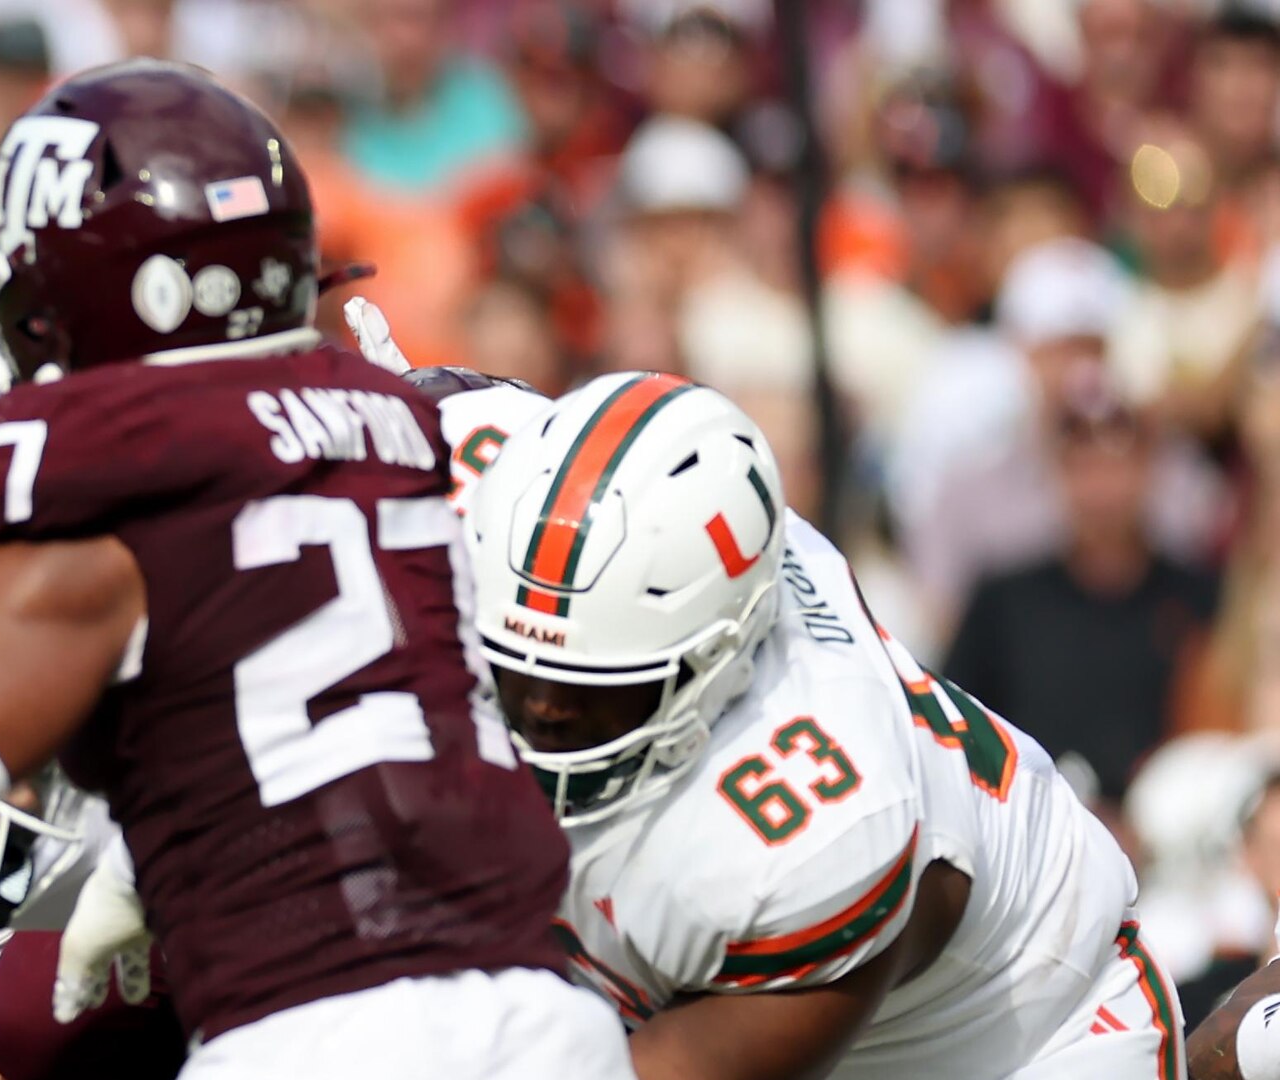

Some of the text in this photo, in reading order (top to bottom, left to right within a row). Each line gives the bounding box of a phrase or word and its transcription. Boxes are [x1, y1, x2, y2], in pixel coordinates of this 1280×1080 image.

[232, 494, 519, 808] 27
[503, 616, 566, 648] MIAMI
[716, 715, 863, 847] 63
